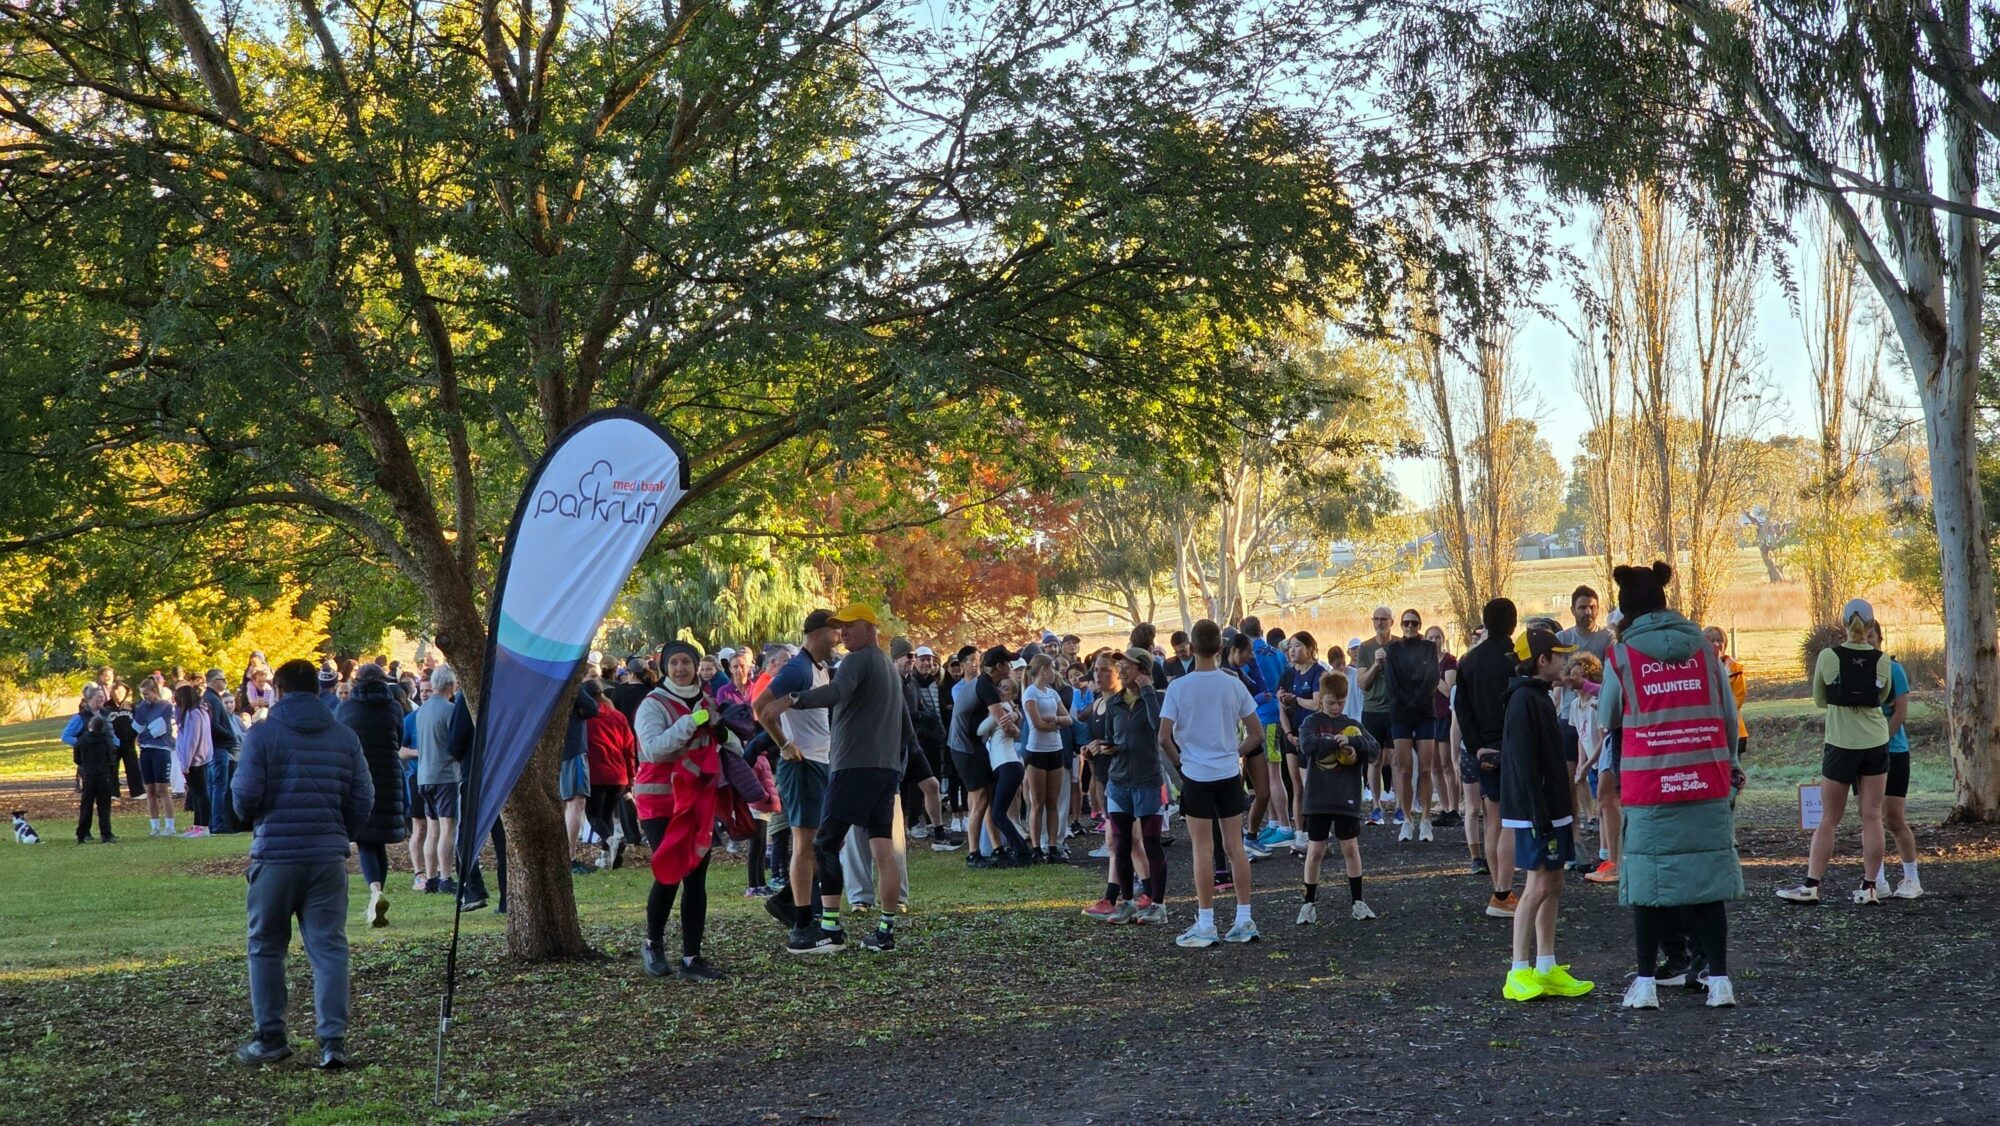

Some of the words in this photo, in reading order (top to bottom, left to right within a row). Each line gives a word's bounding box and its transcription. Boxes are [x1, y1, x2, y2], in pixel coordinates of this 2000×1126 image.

[613, 480, 667, 492] medibank
[534, 477, 658, 525] parkrun
[1641, 658, 1698, 678] parun
[1643, 679, 1702, 696] VOLUNTEER
